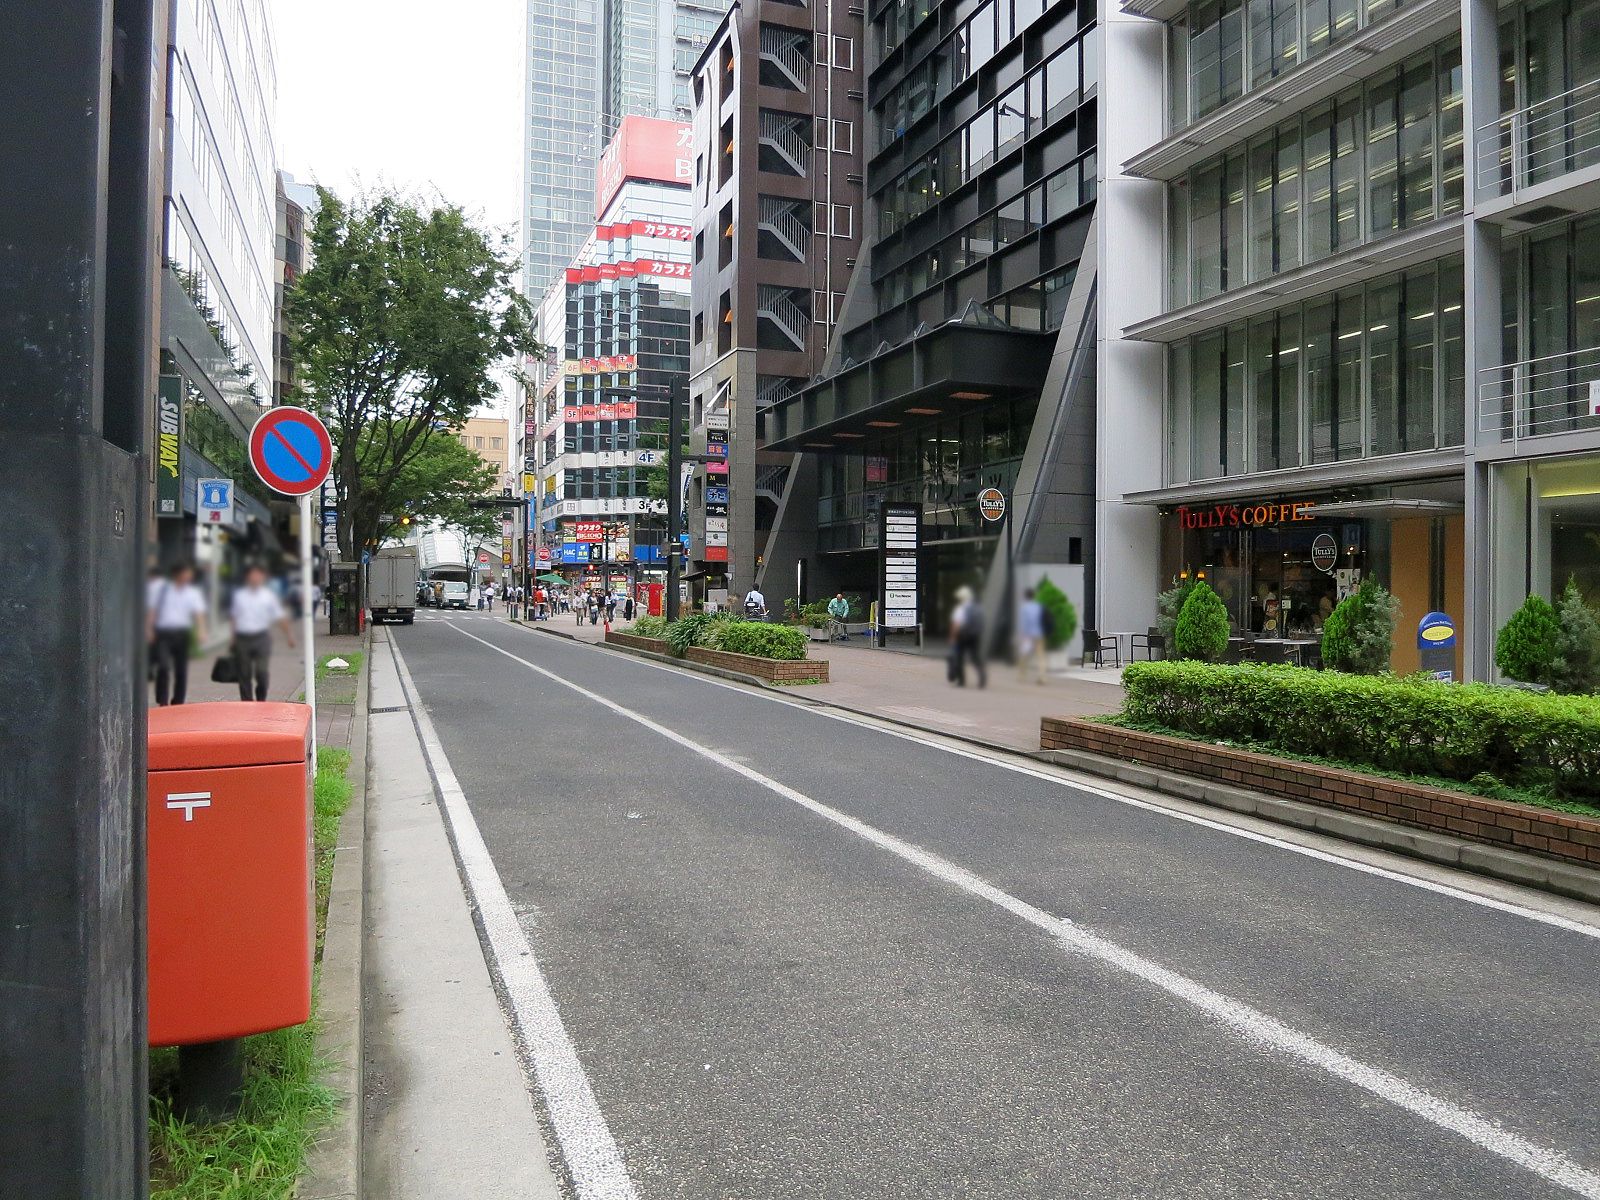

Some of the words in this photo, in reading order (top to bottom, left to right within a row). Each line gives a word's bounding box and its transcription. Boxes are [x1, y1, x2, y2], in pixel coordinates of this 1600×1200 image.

[645, 224, 692, 238] カラオケ
[567, 410, 577, 418] 5F
[160, 396, 179, 478] SUBWAY
[638, 453, 655, 463] 4F
[638, 500, 652, 510] 3F
[1176, 505, 1239, 529] TULLY'S
[1242, 502, 1316, 525] COFFEE
